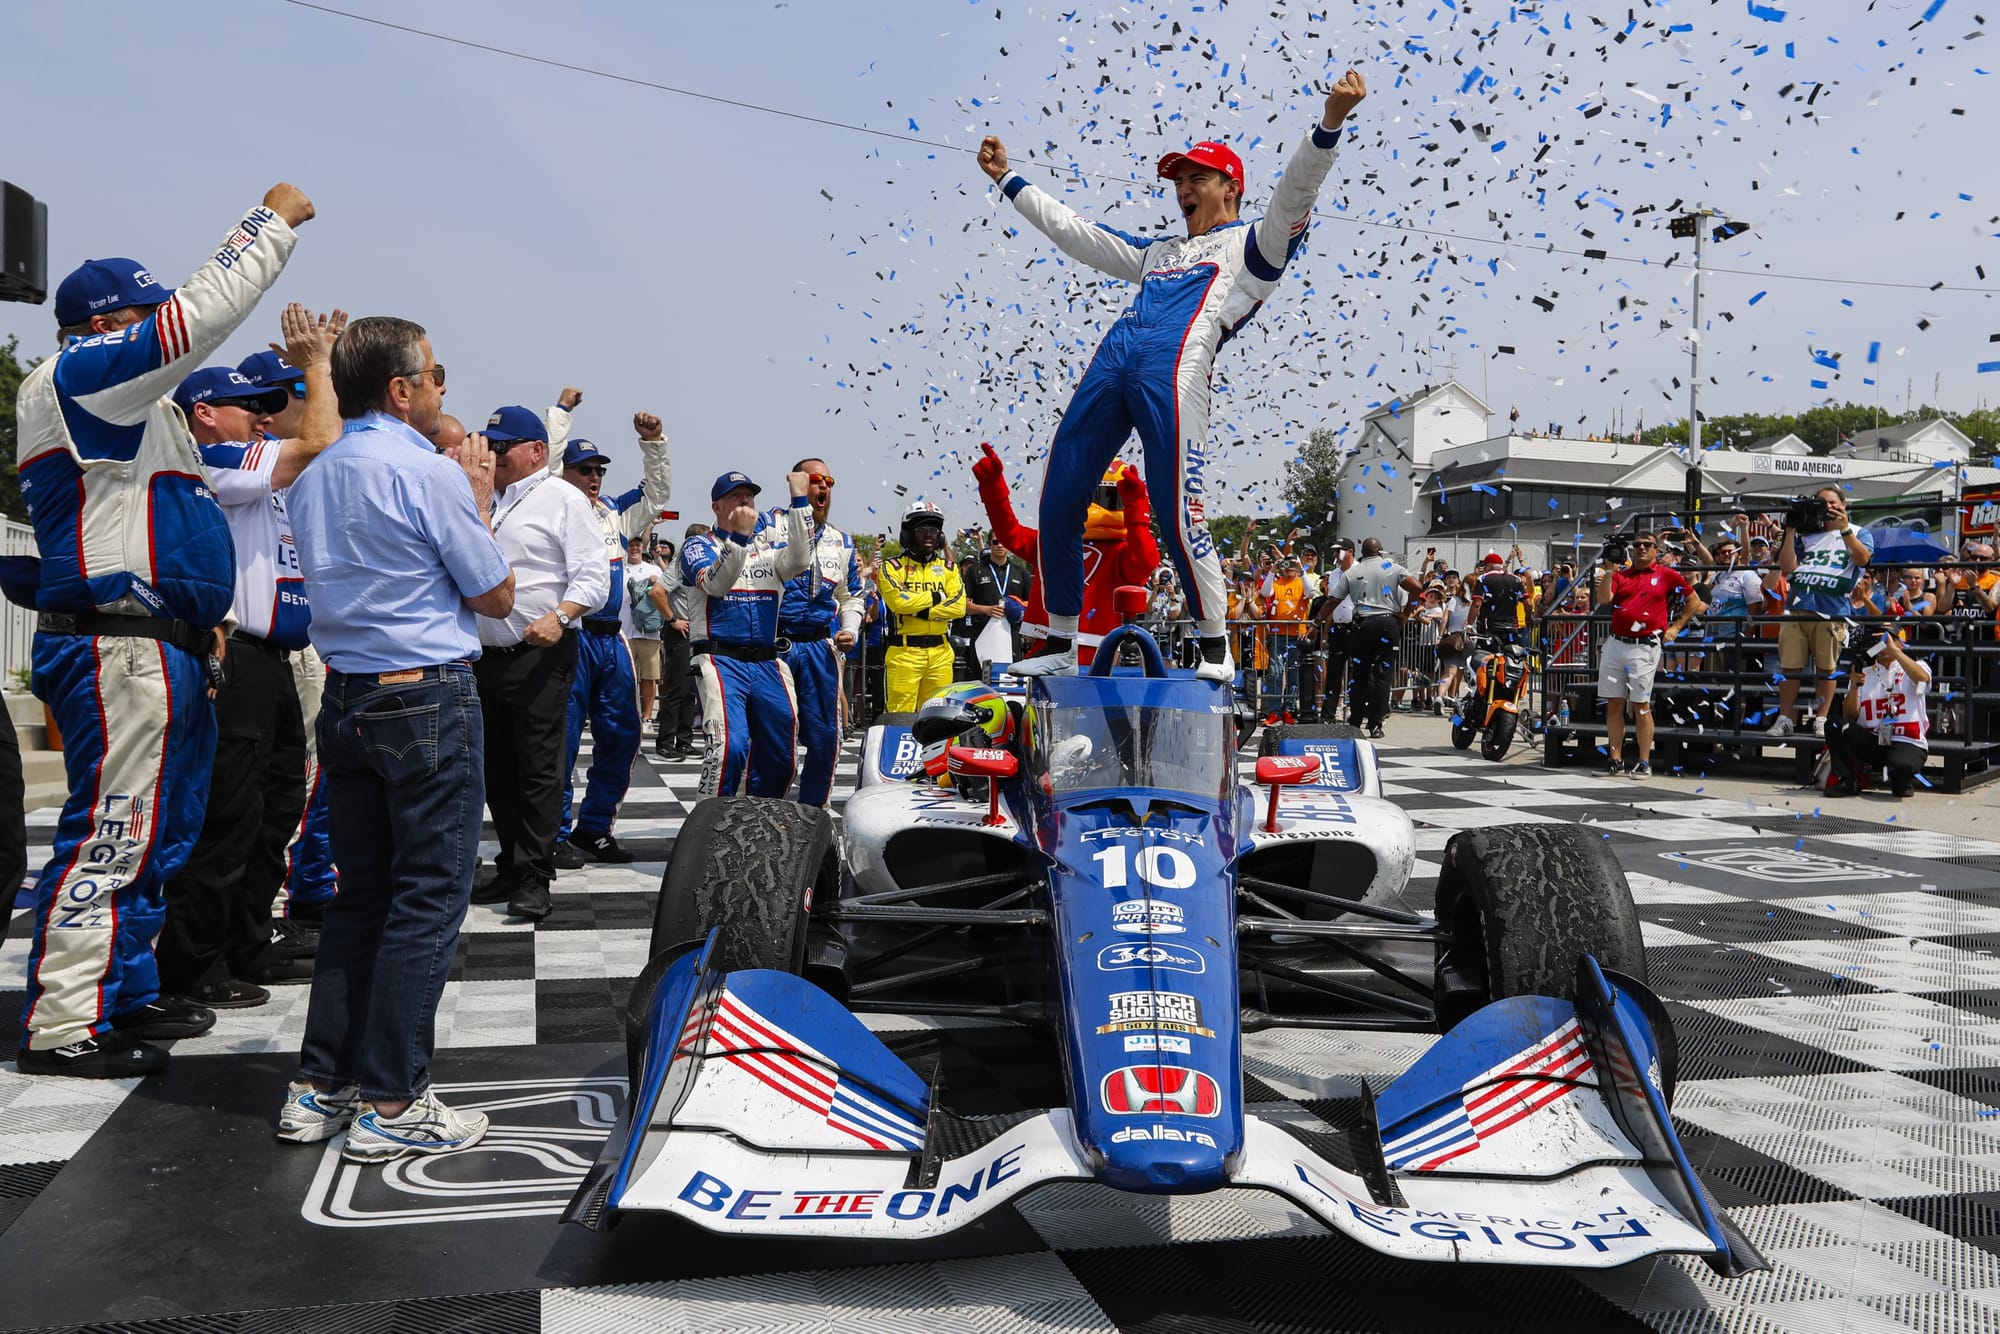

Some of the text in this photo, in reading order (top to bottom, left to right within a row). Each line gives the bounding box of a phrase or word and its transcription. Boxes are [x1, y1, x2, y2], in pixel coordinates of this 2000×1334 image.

[215, 207, 274, 269] BE THE ONE
[1775, 459, 1843, 475] ROAD AMERICA
[1184, 439, 1213, 560] ONE THE BE
[1803, 550, 1849, 569] 253
[1795, 572, 1838, 588] PHOTO
[1861, 693, 1906, 721] 152
[1080, 829, 1204, 847] LEGION
[1255, 830, 1355, 841] Firestone
[56, 795, 129, 928] LEGION
[1093, 845, 1197, 889] 10
[1109, 994, 1196, 1011] TRENCH
[1109, 1006, 1197, 1022] SHORING
[1126, 1022, 1187, 1032] 50 YEARS
[1111, 1124, 1217, 1149] dallara
[677, 1143, 1026, 1221] BE THE ONE
[1294, 1163, 1652, 1252] LEGION
[1386, 1206, 1628, 1233] AMERICAN
